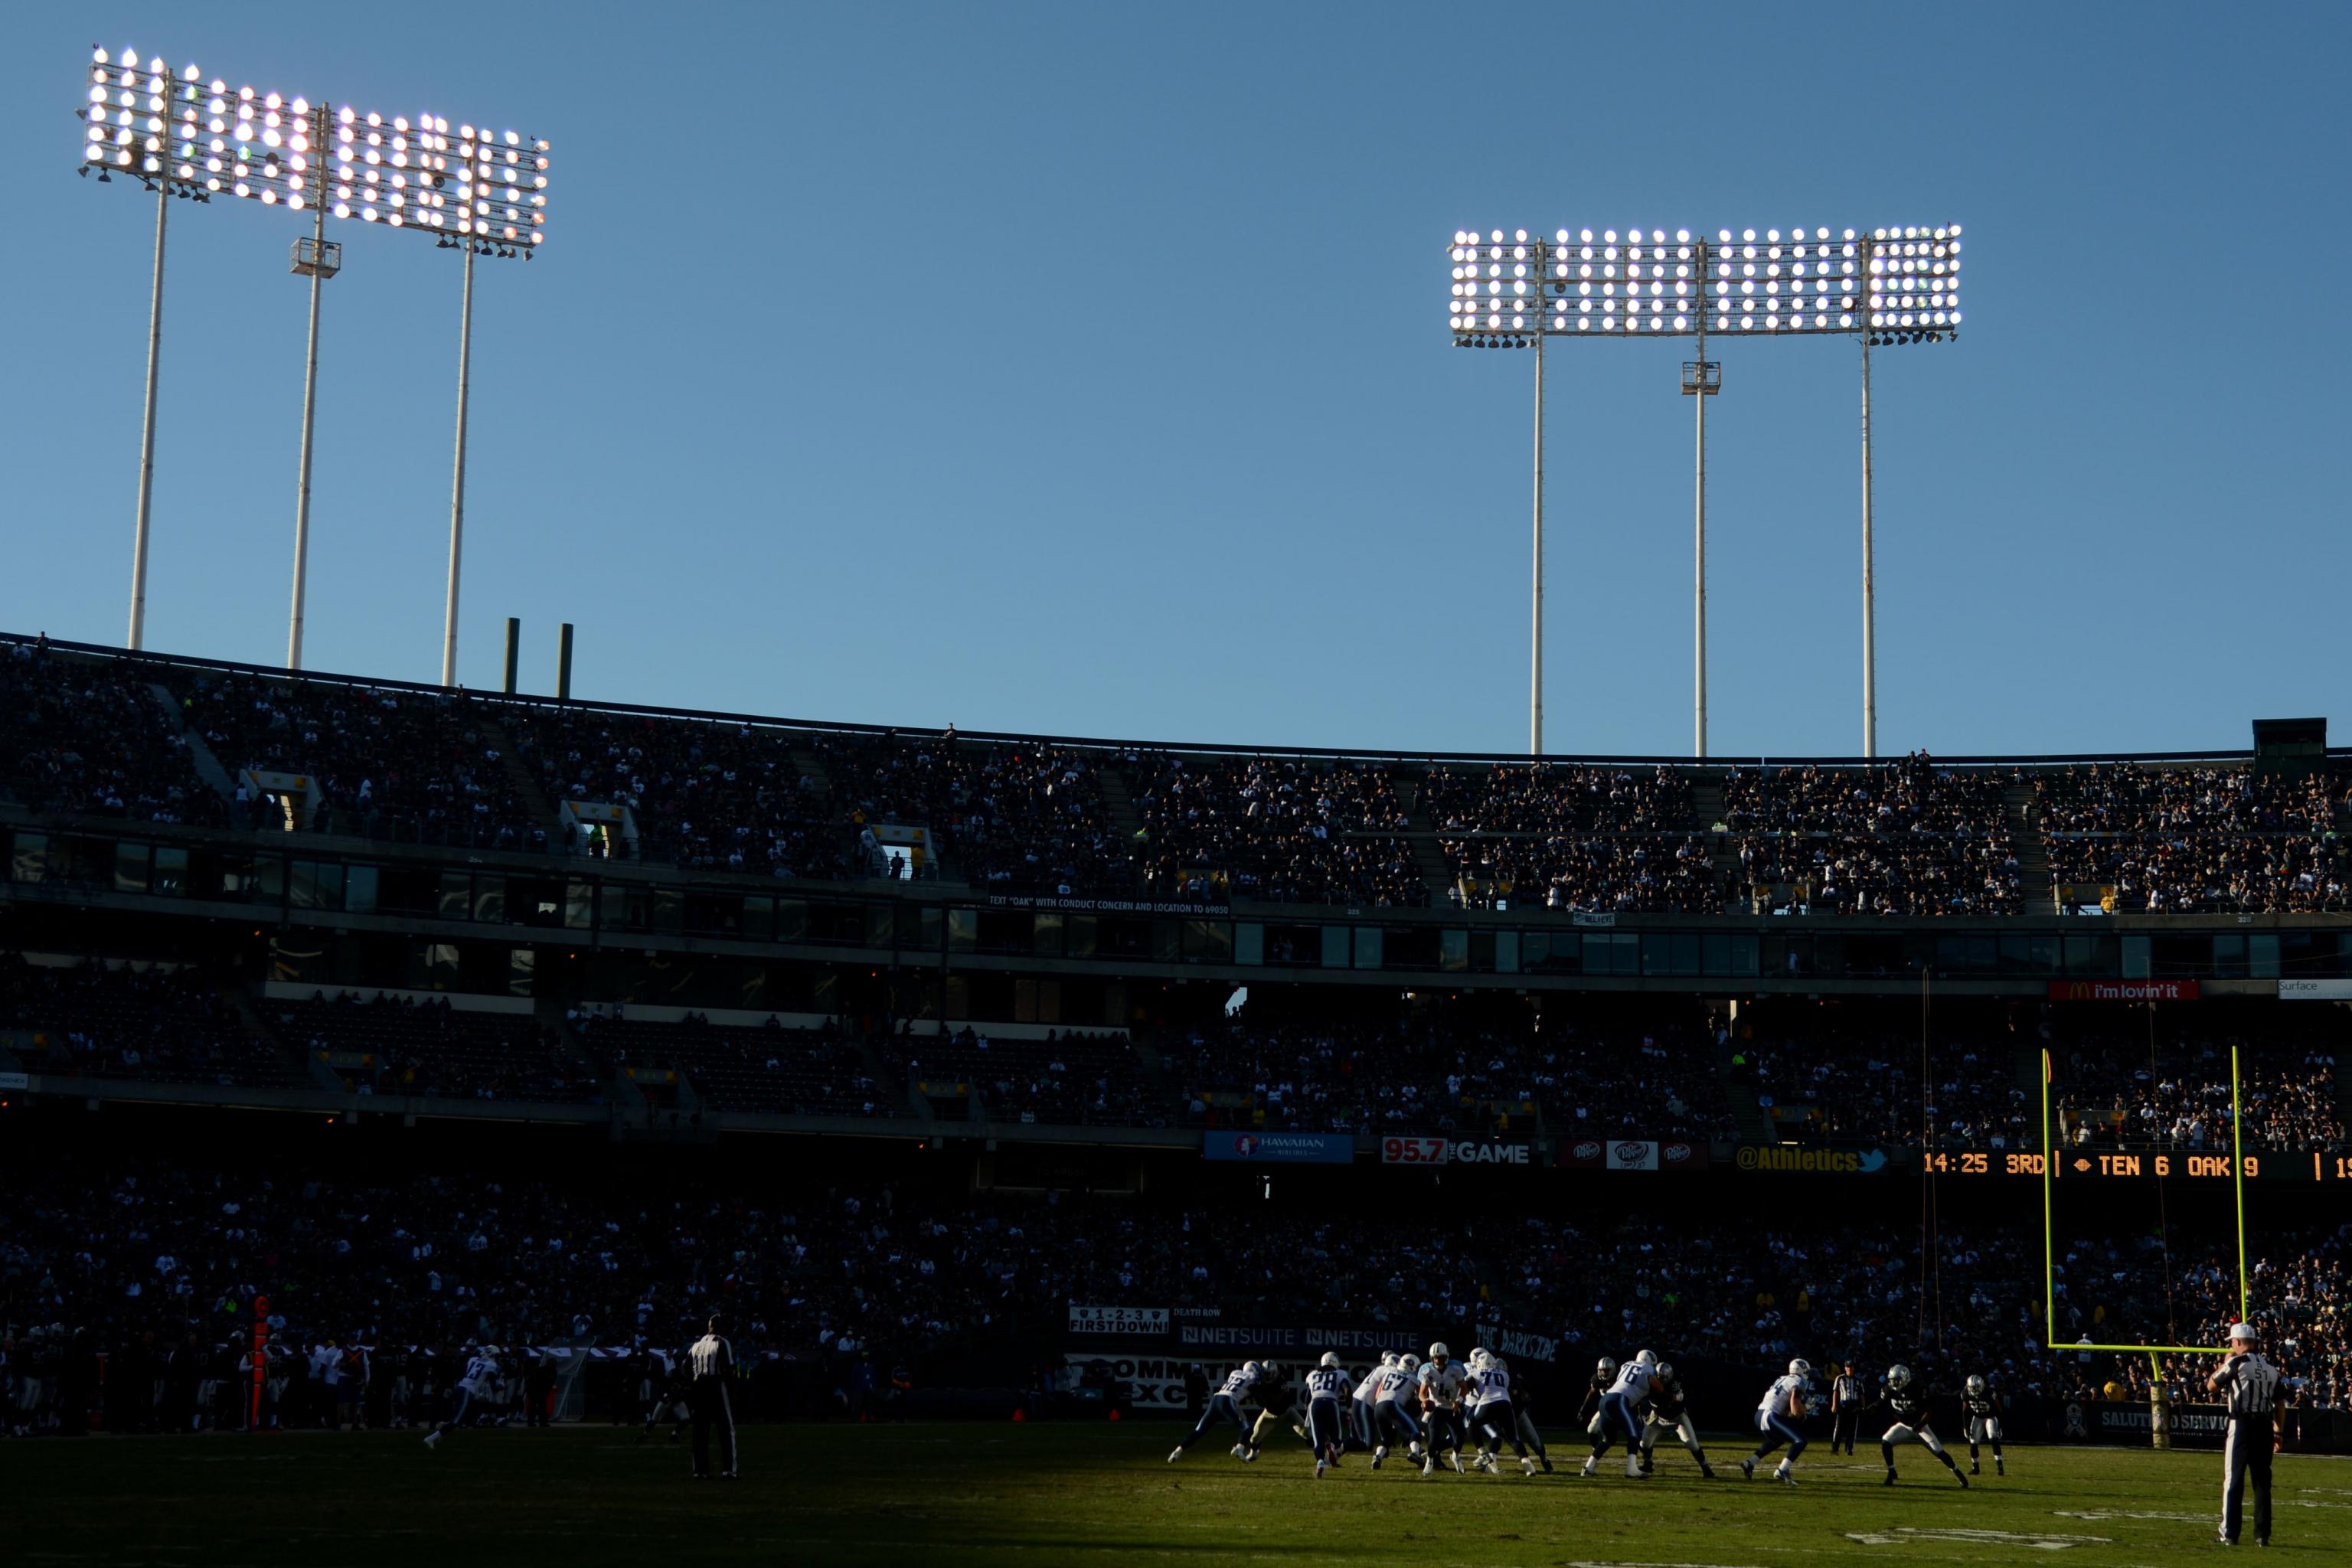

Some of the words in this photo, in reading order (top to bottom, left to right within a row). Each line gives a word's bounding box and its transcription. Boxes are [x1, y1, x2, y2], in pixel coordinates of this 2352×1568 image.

[989, 895, 1007, 905] TEXT
[1036, 897, 1057, 907] WITH
[1059, 899, 1095, 909] CONDUCT
[1097, 900, 1134, 910] CONCERN
[1135, 902, 1152, 911] AND
[1154, 903, 1191, 913] LOCATION
[1193, 904, 1204, 913] TO
[1205, 905, 1229, 914] 69050
[2166, 984, 2179, 998] it
[2279, 981, 2318, 991] Surface
[1261, 1137, 1325, 1148] HAWAIIAN
[1385, 1138, 1444, 1162] 95.7
[1456, 1141, 1530, 1165] GAME
[1736, 1145, 1858, 1172] @Athletics
[1924, 1152, 1988, 1174] 14:25
[2005, 1153, 2045, 1175] 3RD
[2098, 1155, 2141, 1177] TEN
[2154, 1155, 2171, 1177] 6
[2187, 1155, 2231, 1178] OAK
[2243, 1155, 2259, 1178] 9
[1173, 1307, 1202, 1317] DEATH
[1203, 1308, 1222, 1318] ROW
[1200, 1327, 1295, 1345] NETSUITE
[1325, 1328, 1419, 1349] NETSUITE
[1475, 1323, 1498, 1351] THE
[466, 1361, 486, 1380] 13
[1481, 1371, 1505, 1387] 70
[2254, 1368, 2268, 1380] 51
[1312, 1371, 1338, 1392] 28
[1383, 1373, 1409, 1391] 67
